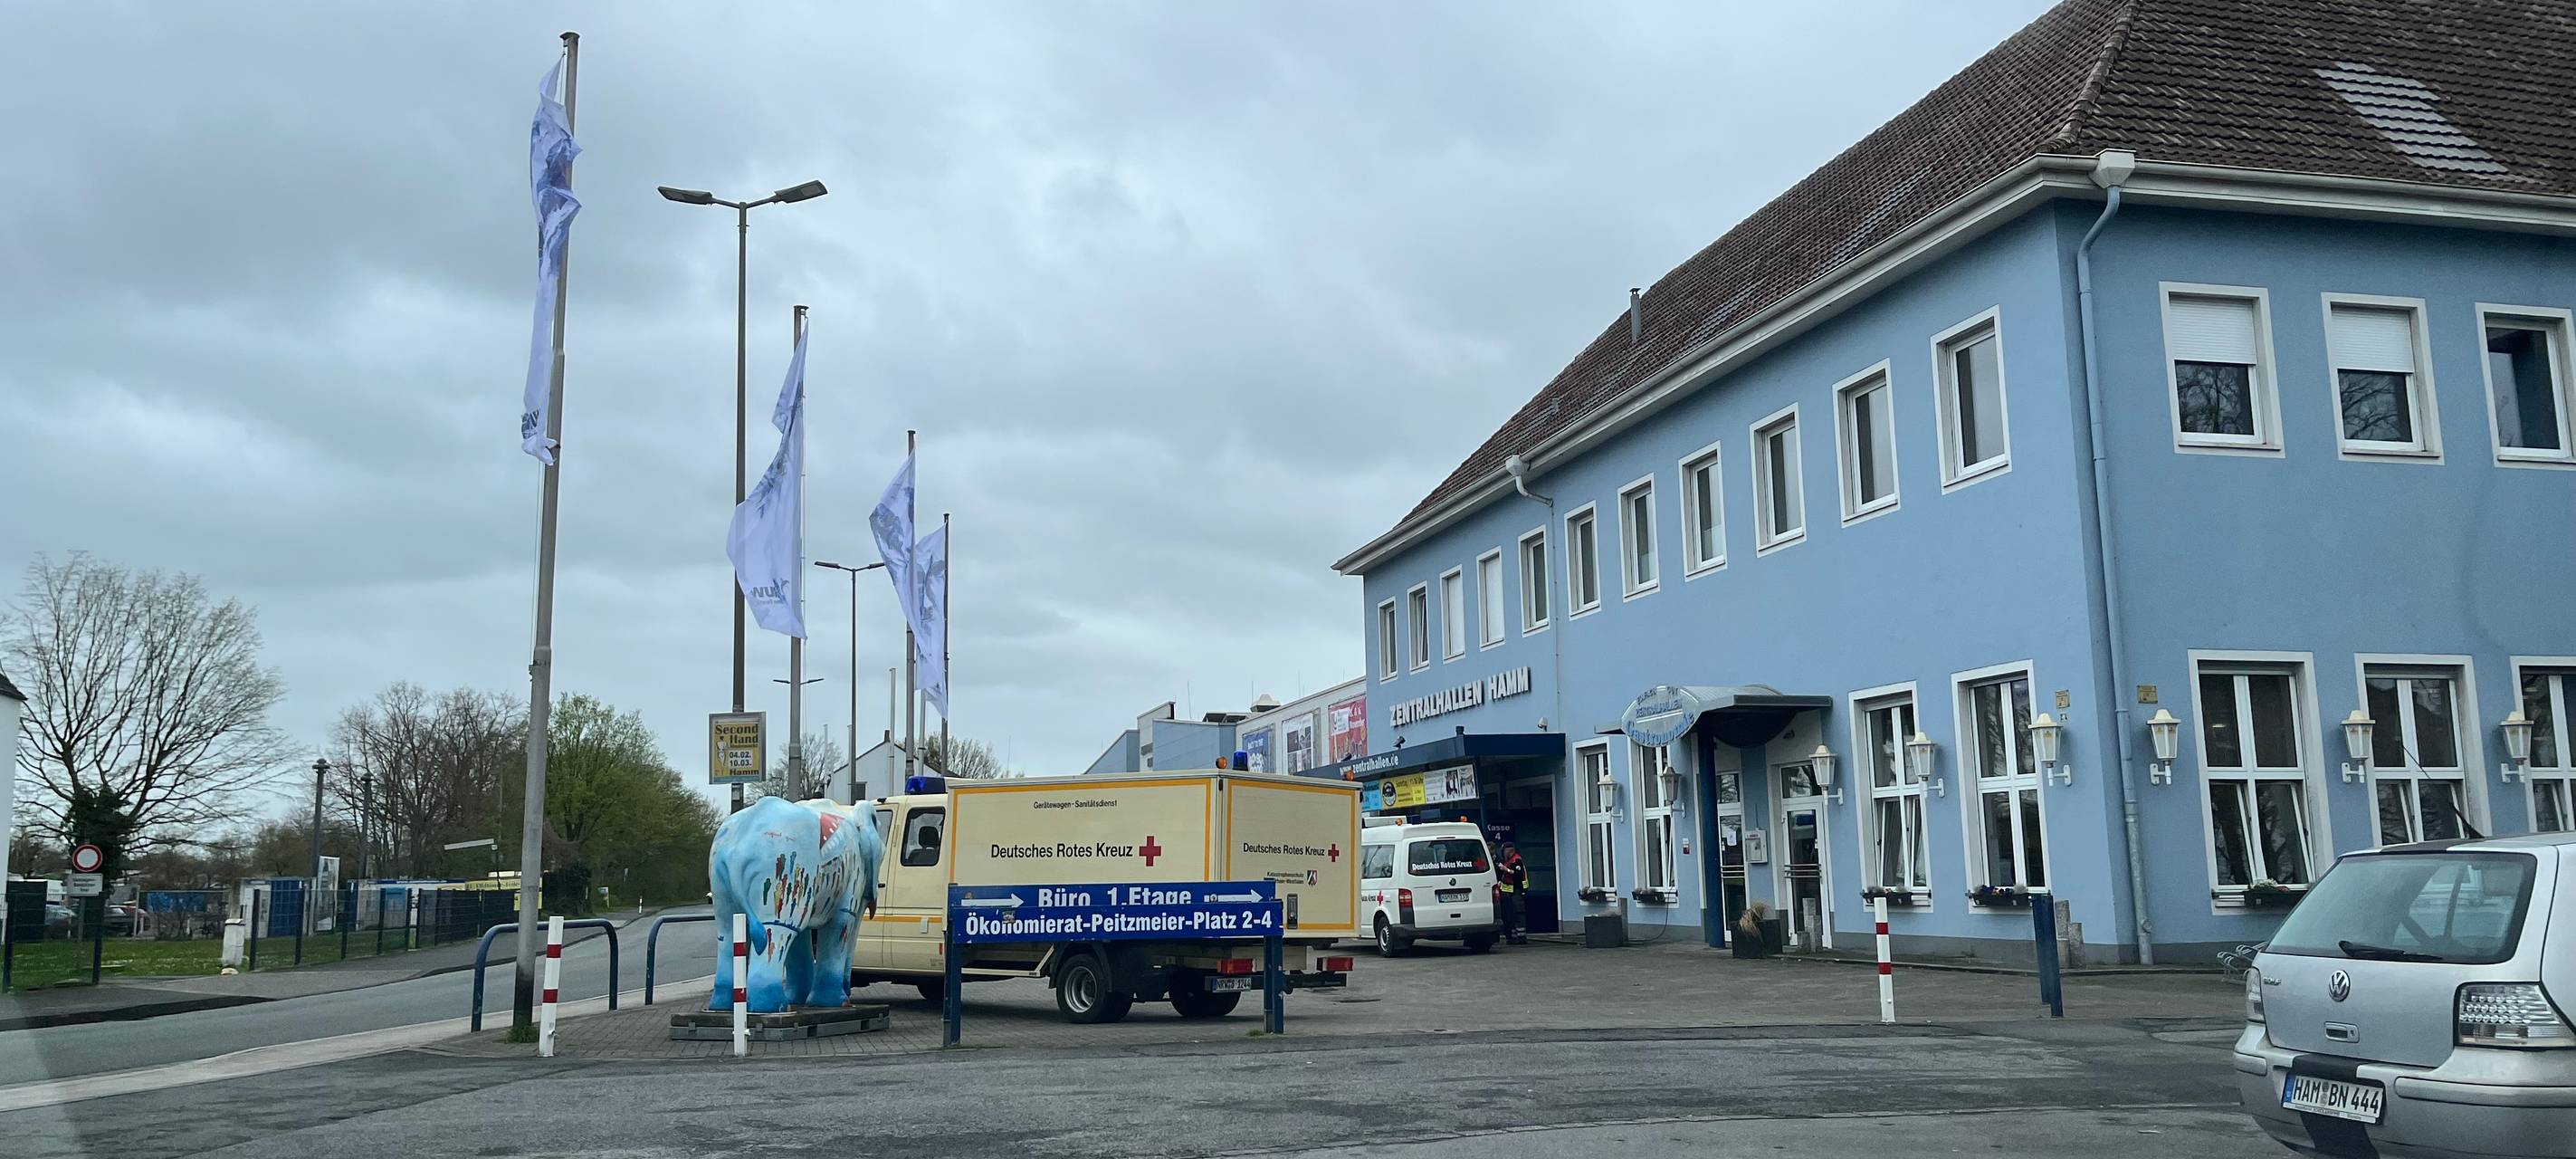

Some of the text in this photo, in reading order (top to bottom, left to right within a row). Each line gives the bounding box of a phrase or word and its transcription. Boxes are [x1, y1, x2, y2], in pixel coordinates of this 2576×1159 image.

[1389, 680, 1483, 726] ZENTRALHALLEN
[1488, 666, 1530, 699] HAMM
[715, 724, 758, 734] Second
[730, 734, 758, 743] Hand
[1340, 755, 1398, 776] wwwzentralhallen.de
[991, 842, 1132, 857] Deutsches Rotes Kreuz
[1243, 842, 1325, 857] Deutsches Rotes Kreuz
[1412, 862, 1439, 870] Deutsches
[1038, 887, 1091, 906] Büro
[966, 910, 1273, 935] Ökonomierat-Peitzmeier-Platz 2-4
[2294, 1078, 2321, 1104] HAM
[2328, 1084, 2349, 1108] BN
[2352, 1087, 2380, 1114] 444
